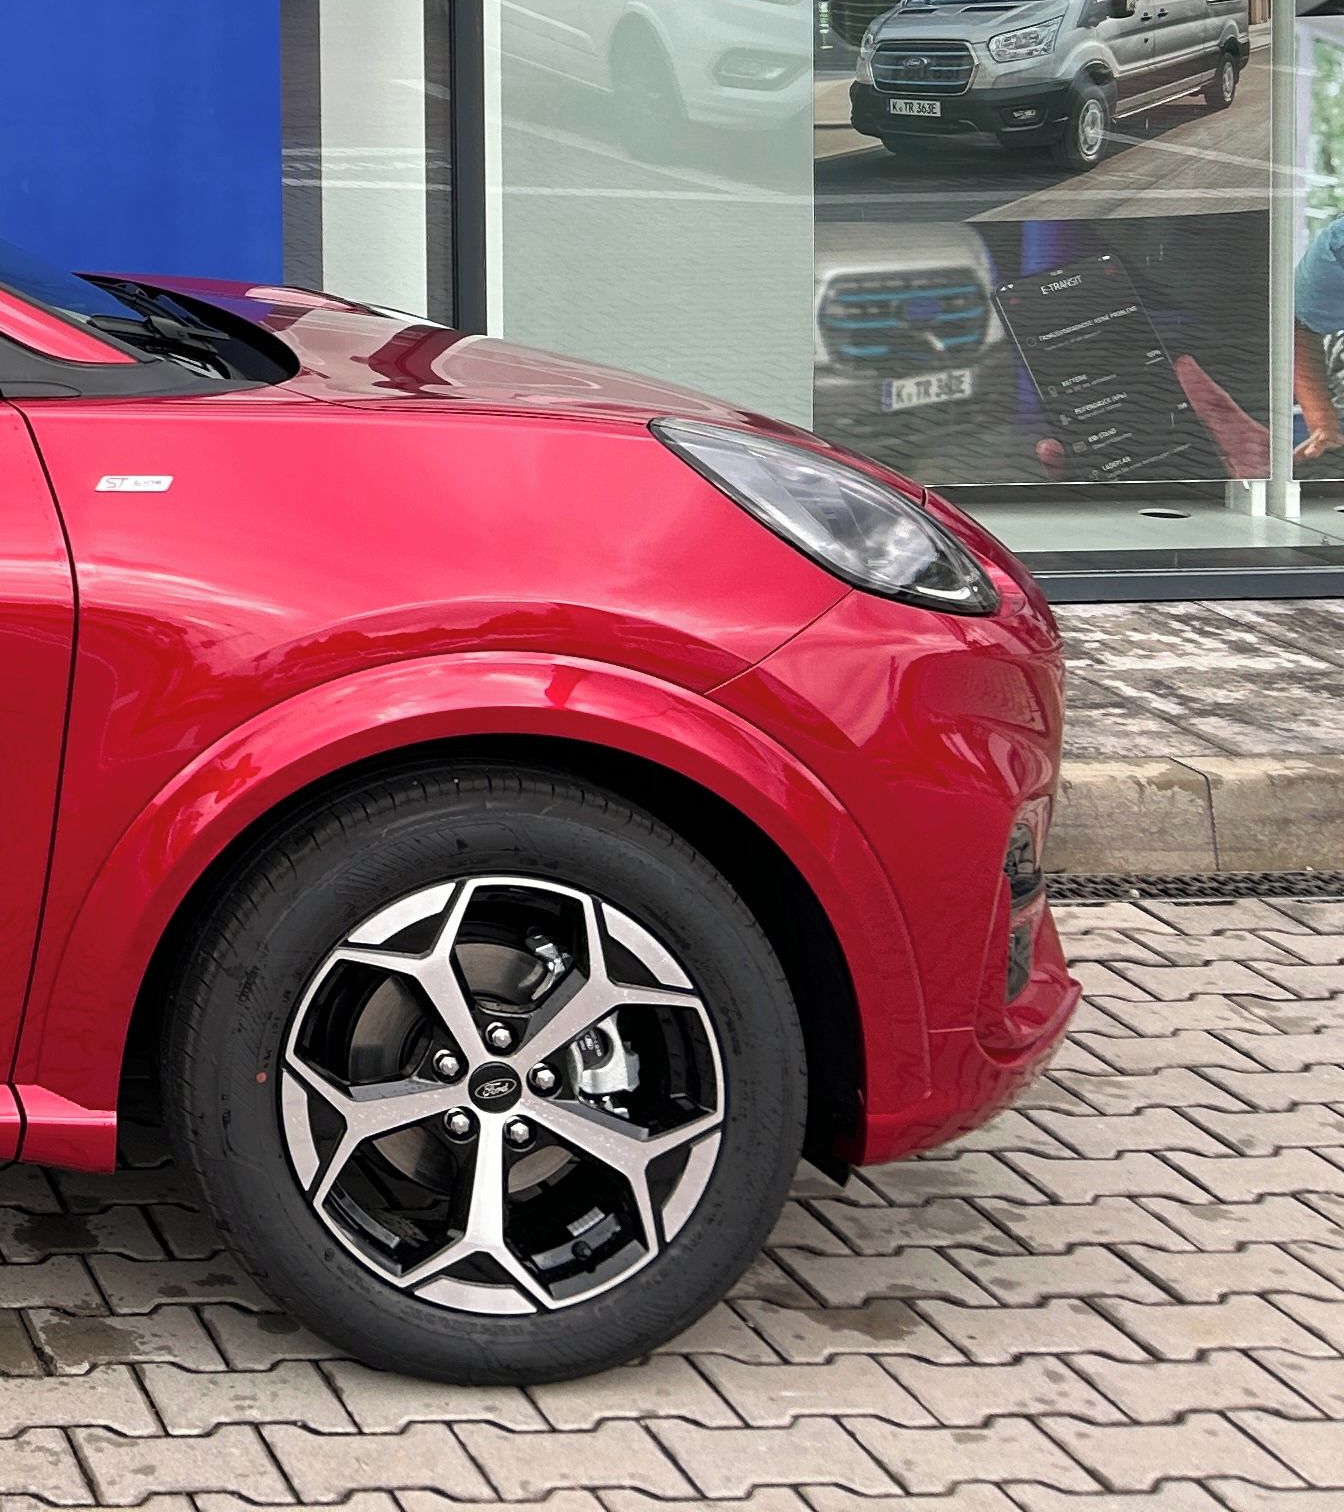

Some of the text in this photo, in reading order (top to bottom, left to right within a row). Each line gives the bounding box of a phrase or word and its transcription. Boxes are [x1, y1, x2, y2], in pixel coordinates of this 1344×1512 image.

[1040, 274, 1083, 295] E-TRANSIT
[105, 477, 130, 489] ST
[482, 1082, 509, 1097] Ford
